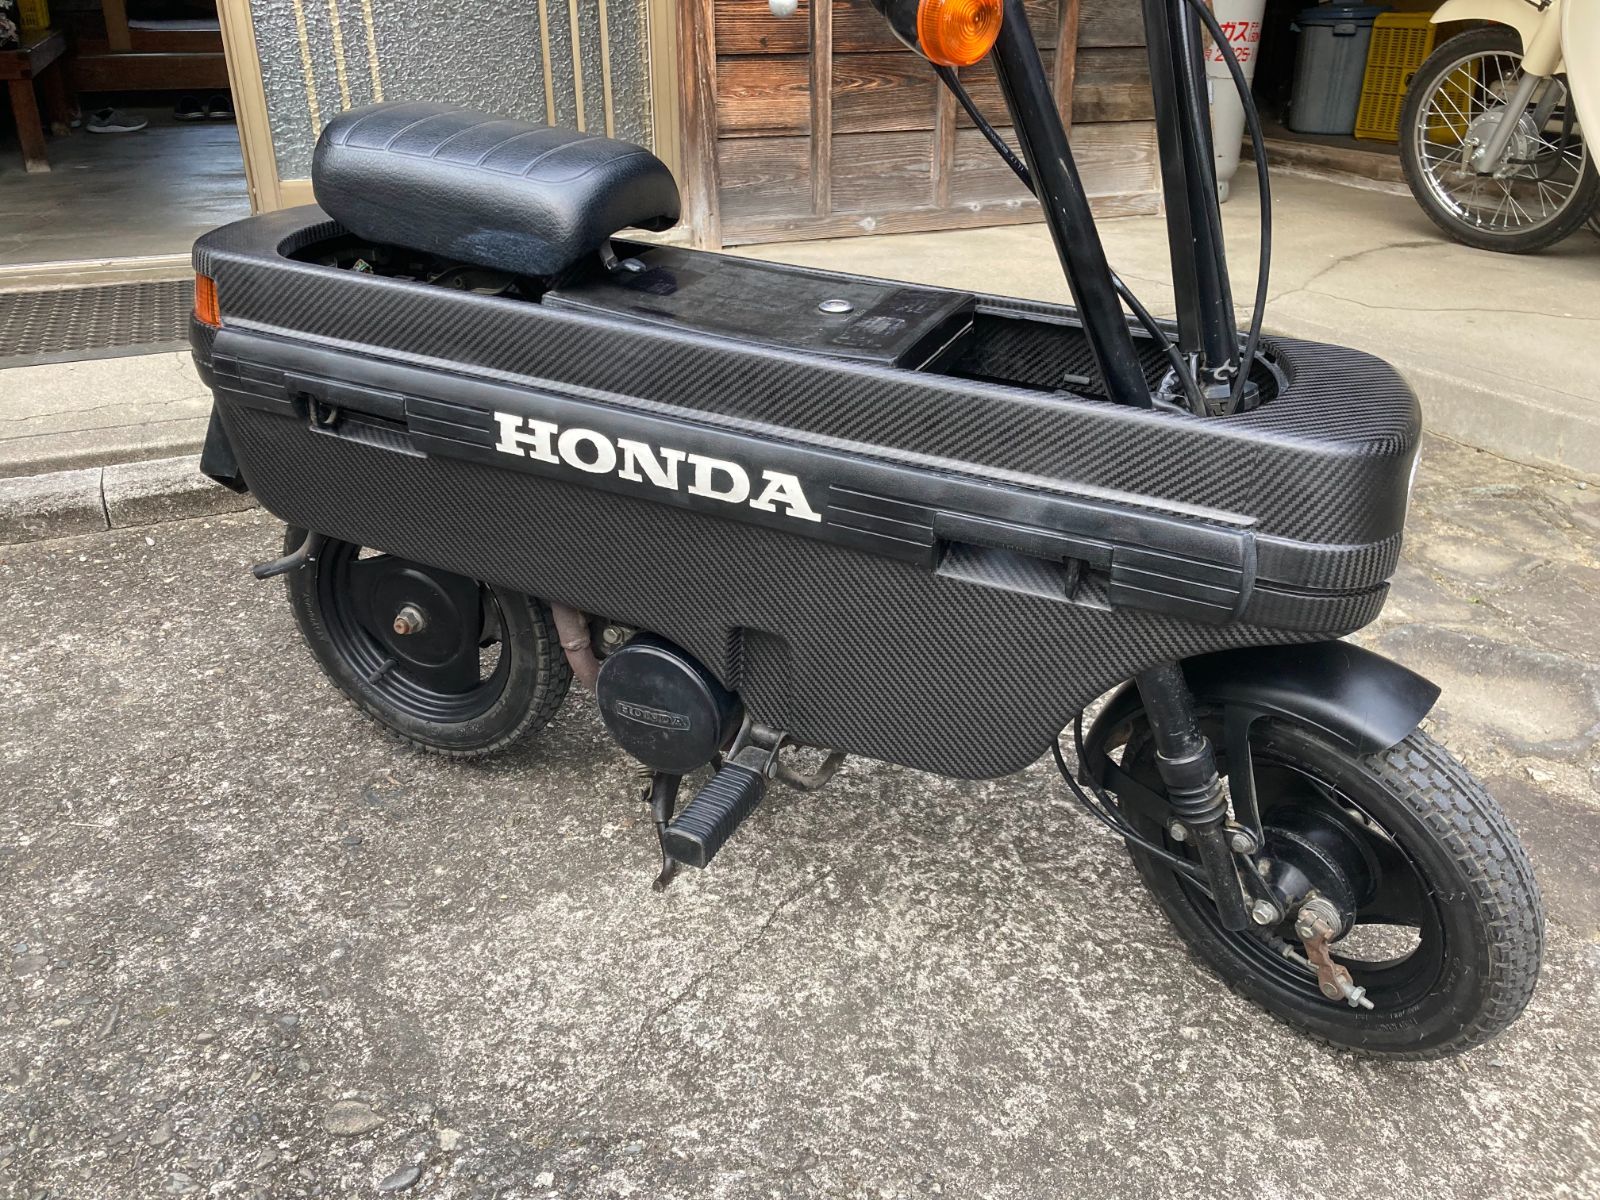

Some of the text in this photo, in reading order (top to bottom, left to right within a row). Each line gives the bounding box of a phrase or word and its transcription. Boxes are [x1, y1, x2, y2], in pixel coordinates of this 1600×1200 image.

[1215, 47, 1250, 62] 225
[494, 411, 822, 522] HONDA
[617, 702, 687, 728] HONDA
